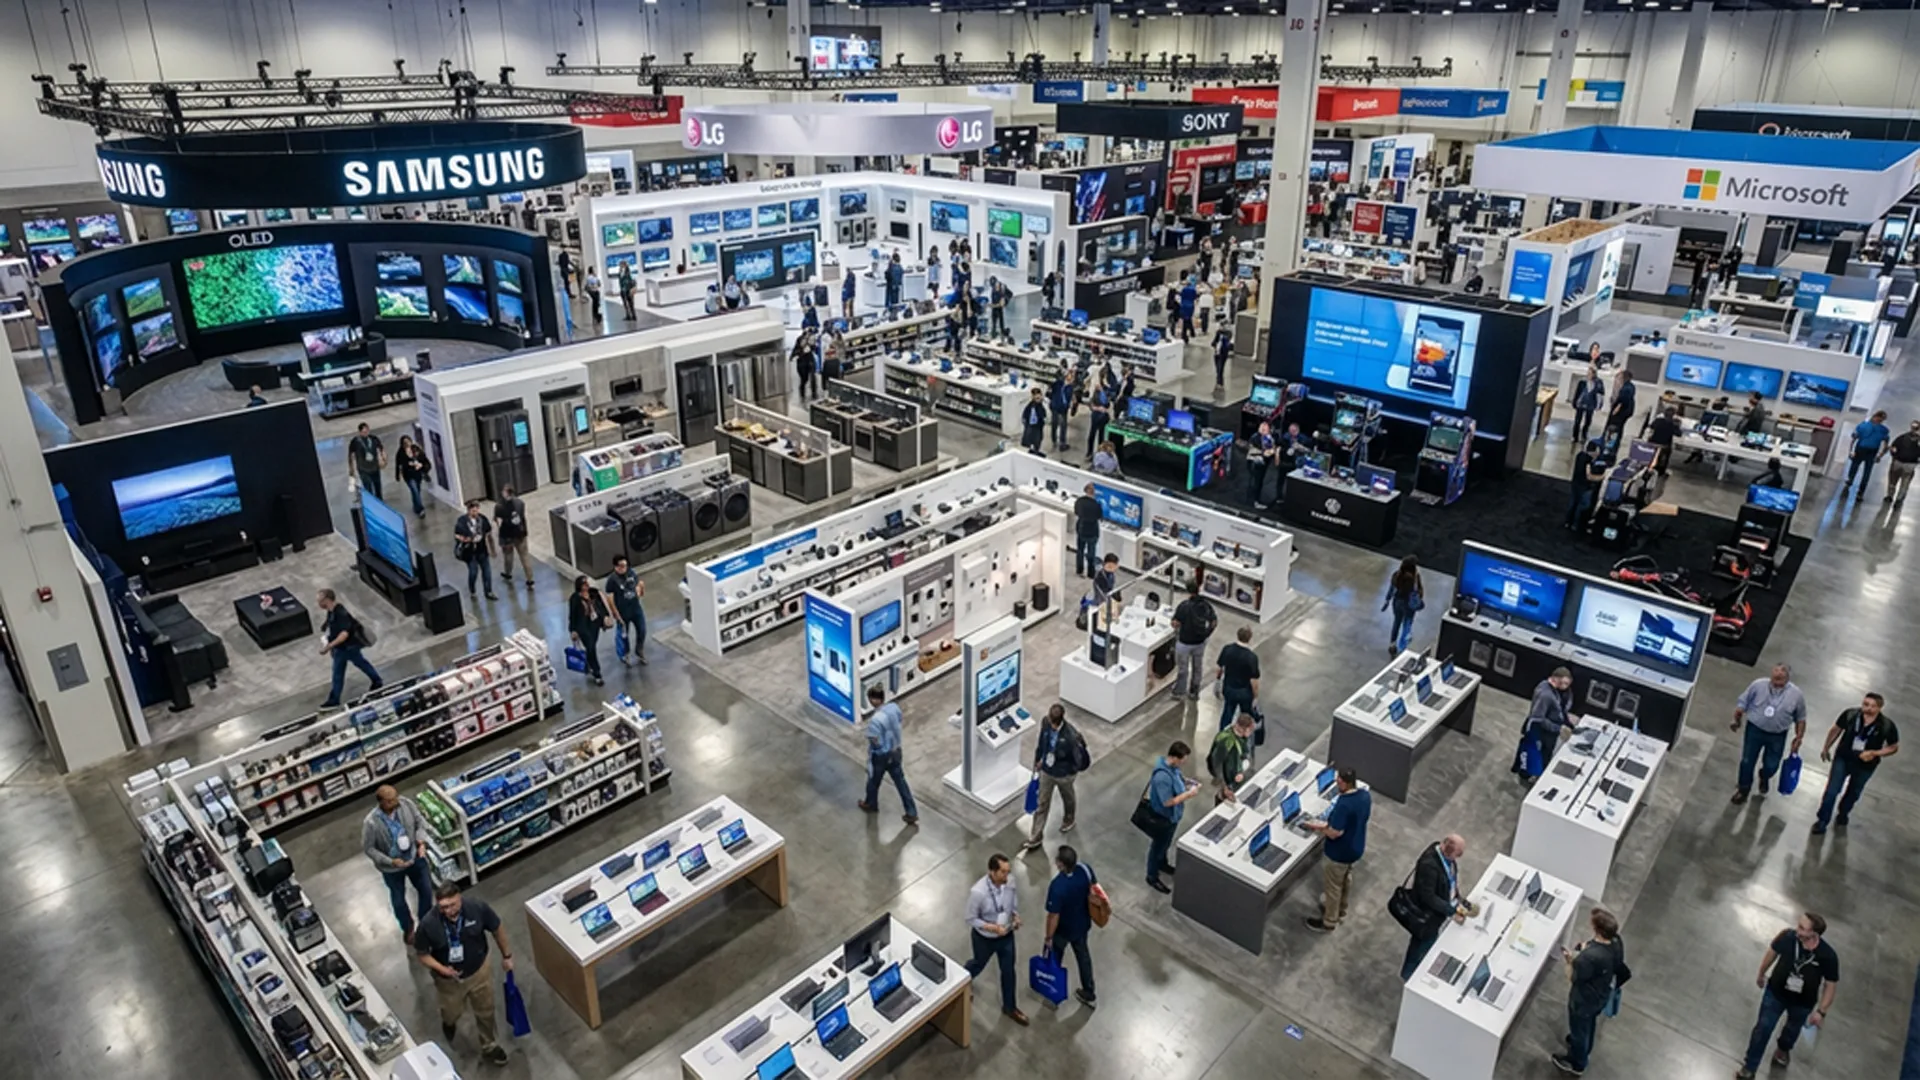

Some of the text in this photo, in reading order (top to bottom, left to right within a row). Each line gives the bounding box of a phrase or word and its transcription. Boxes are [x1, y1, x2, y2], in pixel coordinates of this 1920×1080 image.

[702, 120, 725, 145] LG
[962, 120, 983, 143] LG
[1182, 112, 1230, 132] SONY
[97, 157, 166, 199] SUNG
[343, 147, 545, 197] SAMSUNG
[1726, 176, 1849, 207] Microsoft
[228, 231, 274, 248] OLED
